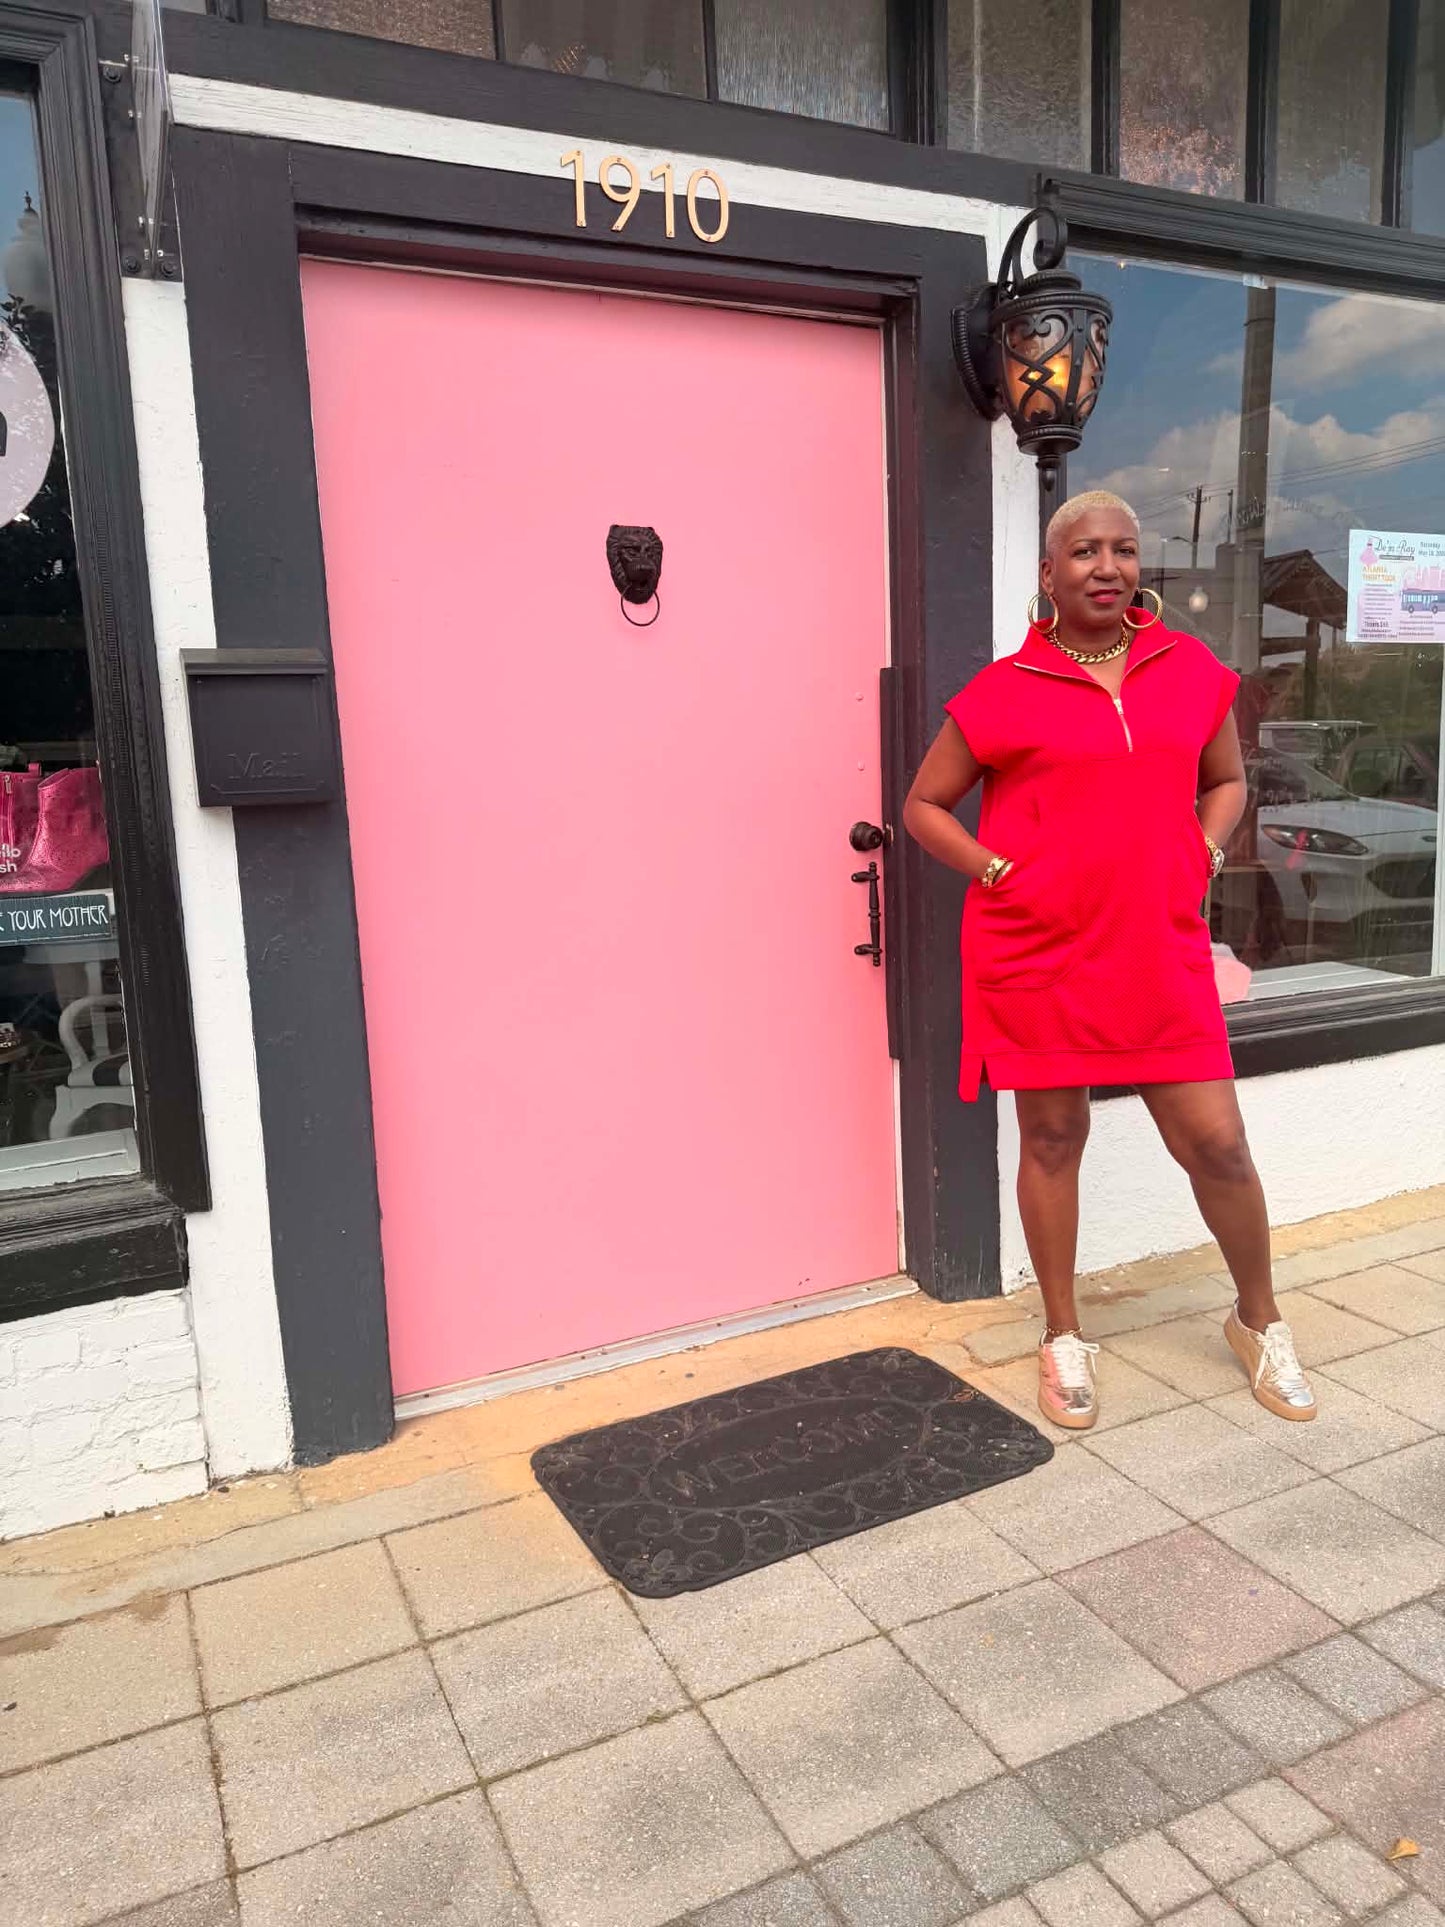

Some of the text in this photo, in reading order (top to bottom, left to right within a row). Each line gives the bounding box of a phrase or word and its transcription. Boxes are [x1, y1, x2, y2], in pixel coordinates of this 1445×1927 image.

[560, 149, 730, 243] 1910
[7, 909, 47, 931] YOUR
[49, 905, 108, 928] MOTHER
